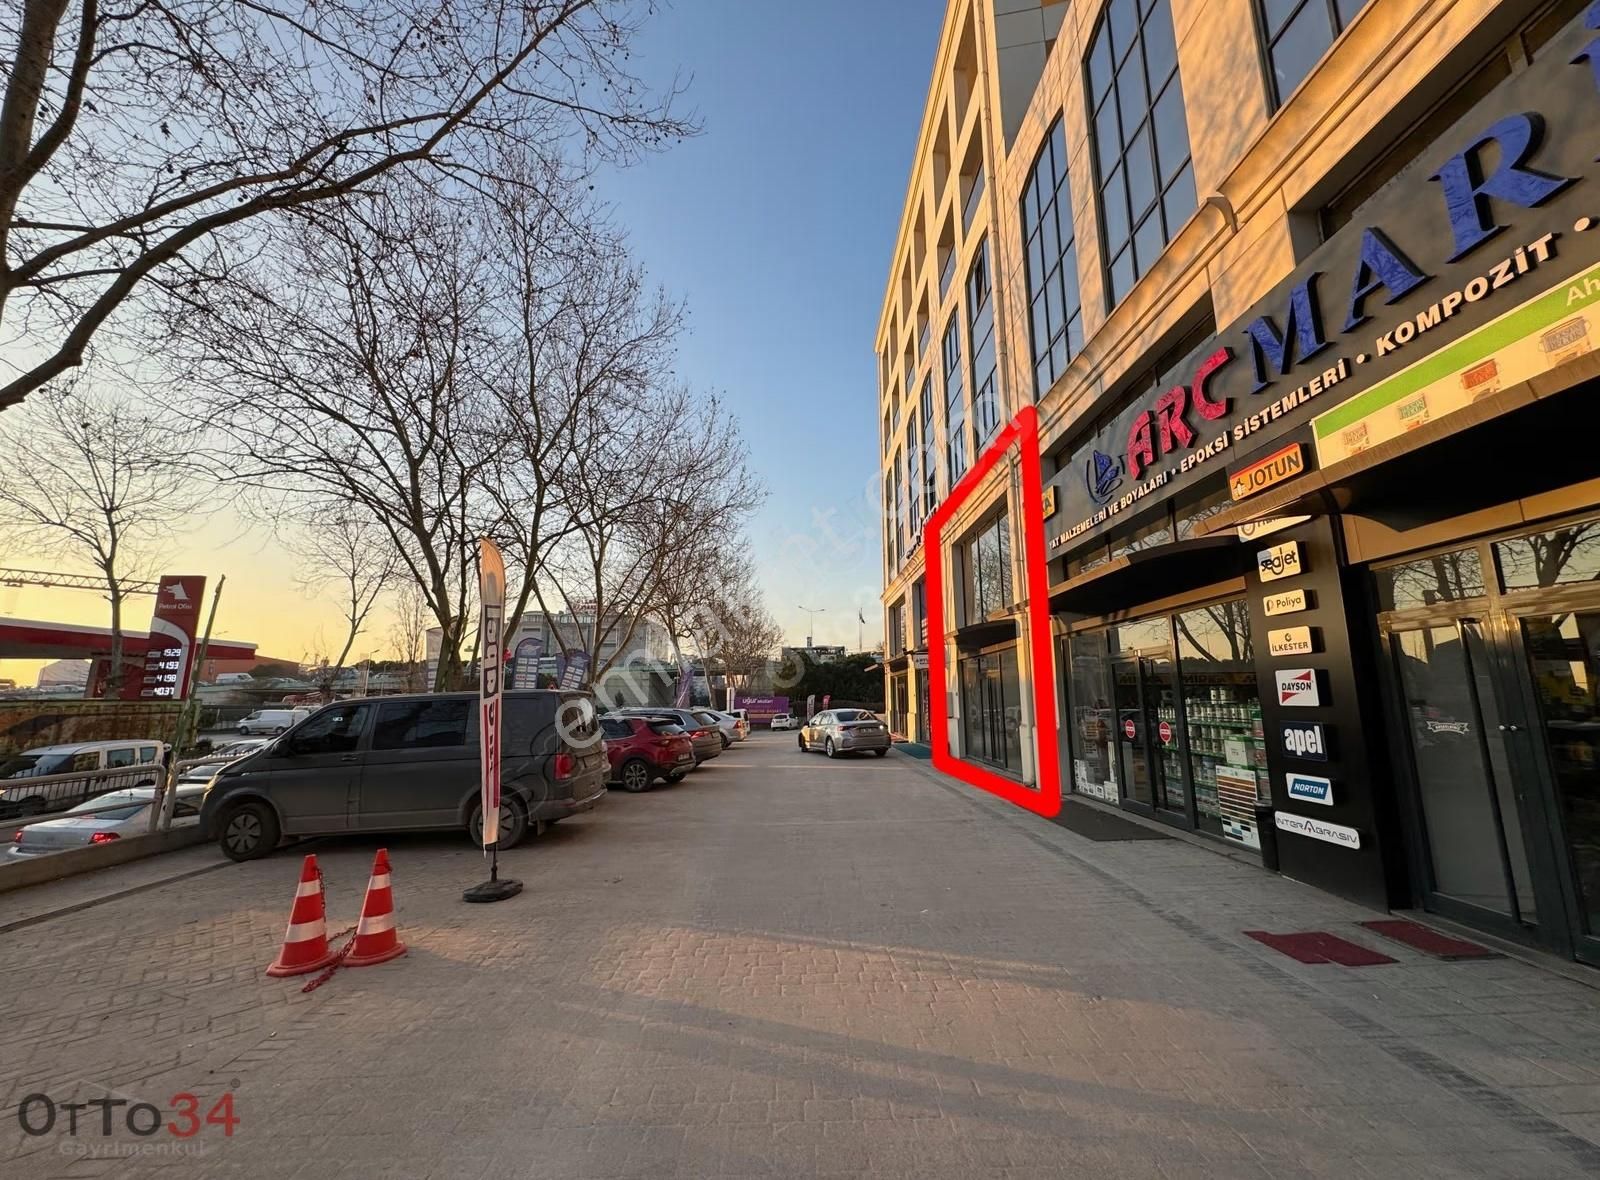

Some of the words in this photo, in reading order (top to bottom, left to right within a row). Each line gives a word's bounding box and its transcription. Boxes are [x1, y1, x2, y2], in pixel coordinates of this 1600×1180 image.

[1060, 506, 1107, 544] MALZEMELERİ
[1107, 503, 1119, 516] VE
[1120, 471, 1168, 509] BOYALARI
[1180, 431, 1229, 474] EPOKSİ
[1233, 358, 1348, 442] SİSTEMLERİ
[1375, 231, 1555, 357] KOMPOZİT
[1126, 346, 1235, 481] ARC
[1248, 451, 1300, 490] JOTUN
[1260, 546, 1298, 576] seajet
[1276, 596, 1302, 609] Poliya
[1281, 682, 1312, 692] DAYSON
[1284, 725, 1323, 756] apel
[1293, 782, 1325, 795] NORTON
